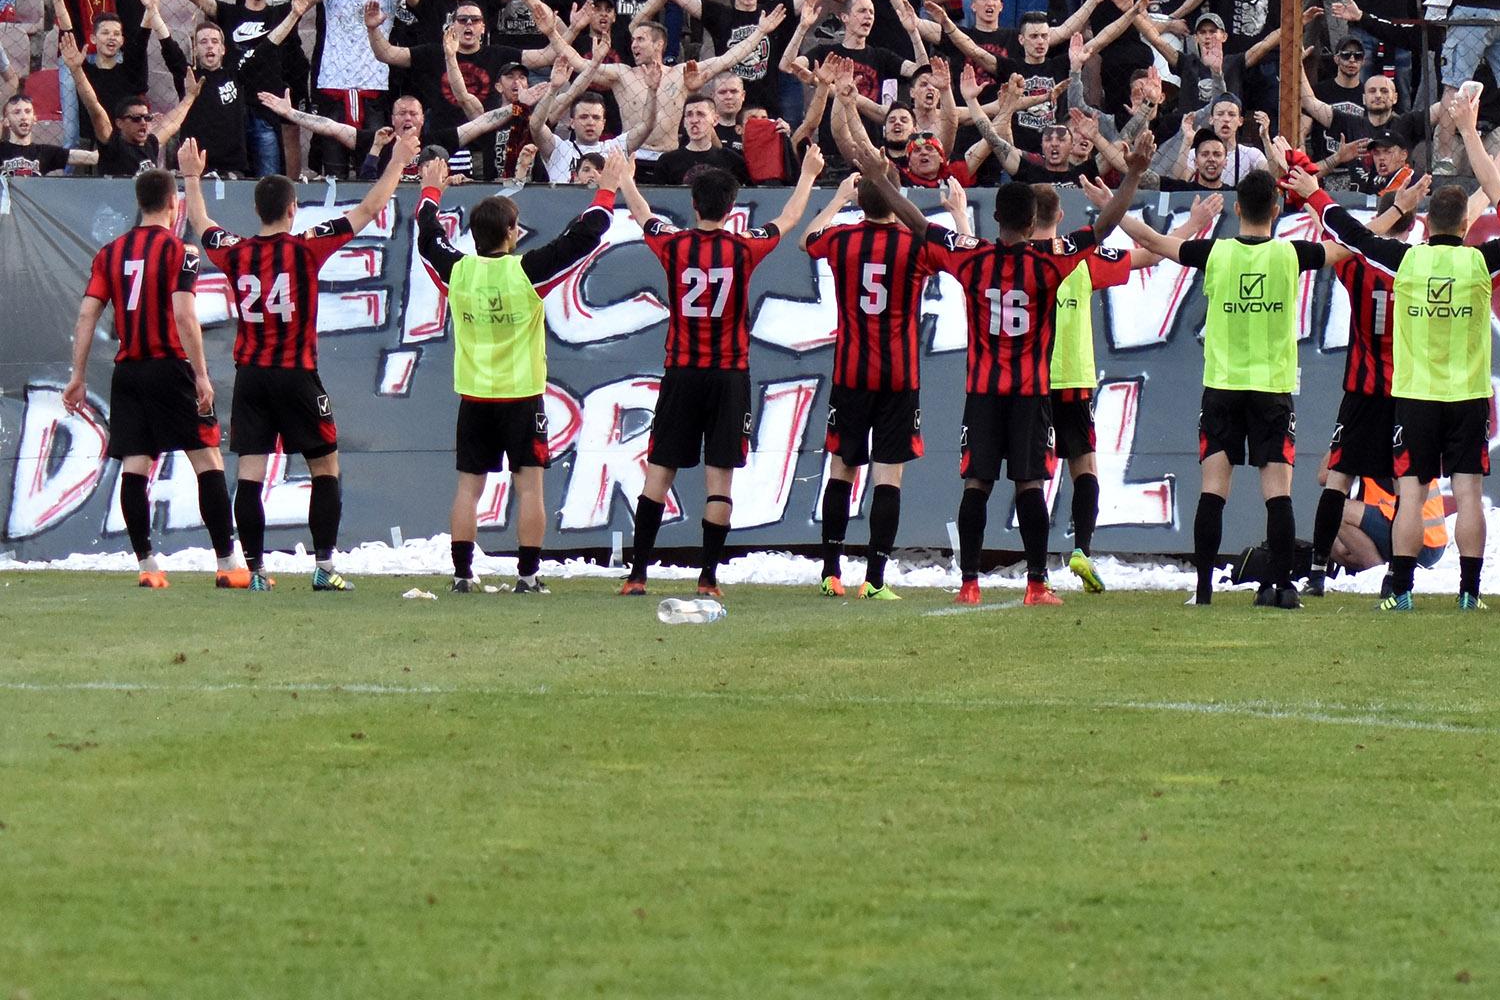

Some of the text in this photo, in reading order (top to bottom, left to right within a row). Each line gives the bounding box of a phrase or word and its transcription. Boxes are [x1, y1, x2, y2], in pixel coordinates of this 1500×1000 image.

[237, 21, 265, 36] NIKE
[124, 260, 145, 311] 7
[237, 272, 296, 324] 24
[681, 267, 734, 318] 27
[860, 262, 887, 316] 5
[1222, 301, 1284, 313] GIVOVA
[985, 288, 1030, 337] 16
[1371, 290, 1394, 335] 1
[1407, 305, 1473, 318] GIVOVA
